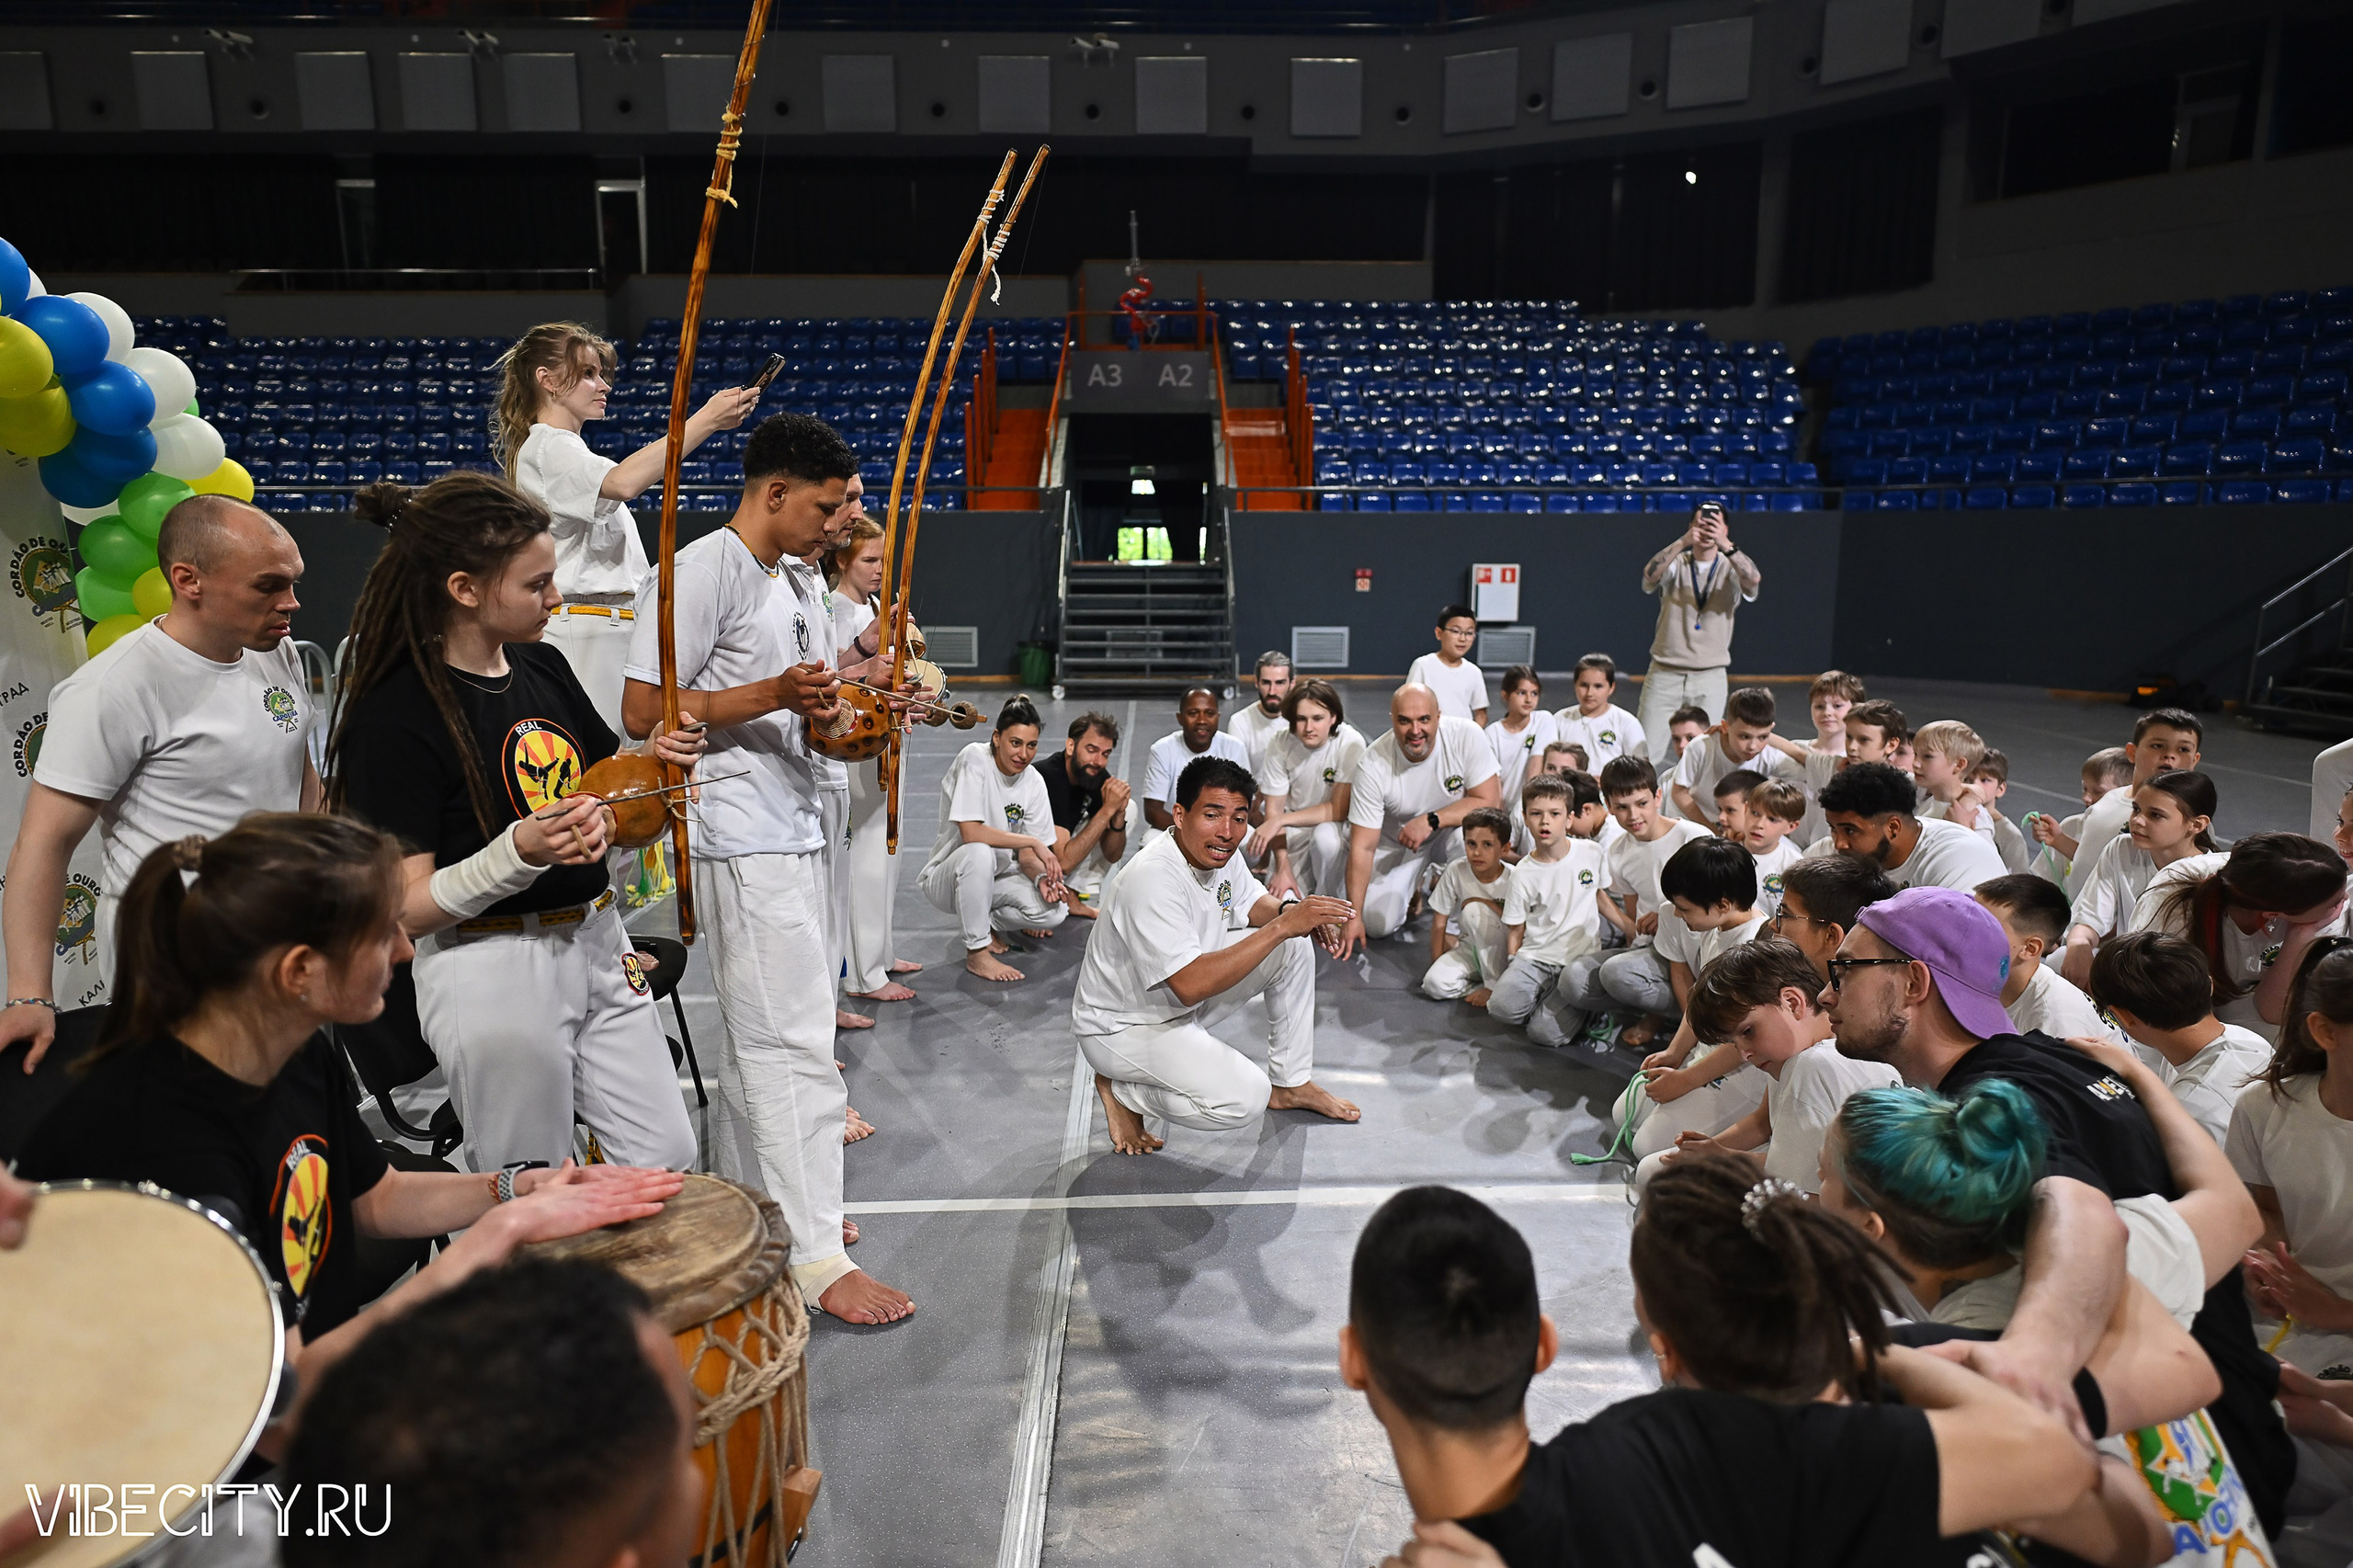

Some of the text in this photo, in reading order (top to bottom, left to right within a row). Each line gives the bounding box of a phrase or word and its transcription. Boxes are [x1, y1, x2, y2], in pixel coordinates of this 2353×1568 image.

[1087, 363, 1192, 387] A3 A2
[28, 536, 46, 549] DE
[515, 721, 542, 736] REAL
[14, 722, 33, 778] CORDÃO
[73, 873, 101, 896] OURO
